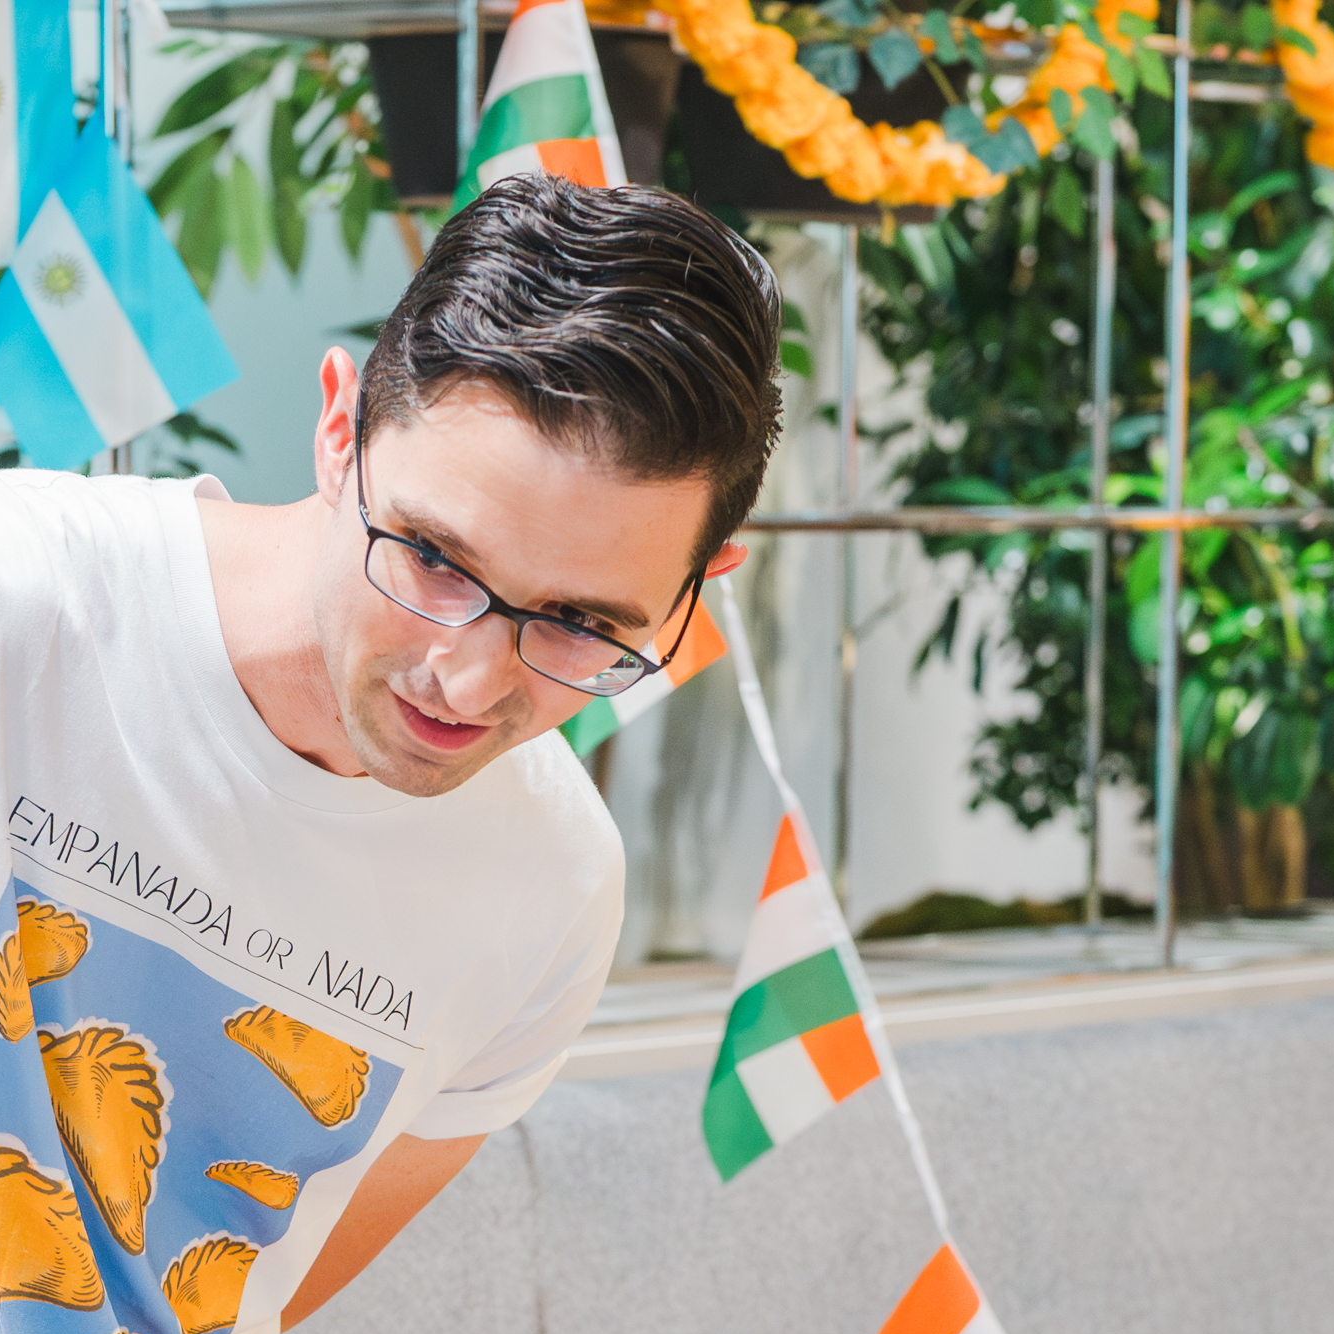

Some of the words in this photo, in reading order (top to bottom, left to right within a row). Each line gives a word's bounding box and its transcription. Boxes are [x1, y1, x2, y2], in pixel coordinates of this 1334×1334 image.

[7, 795, 232, 947] EMPANADA
[246, 928, 293, 970] OR
[308, 950, 413, 1031] NADA
